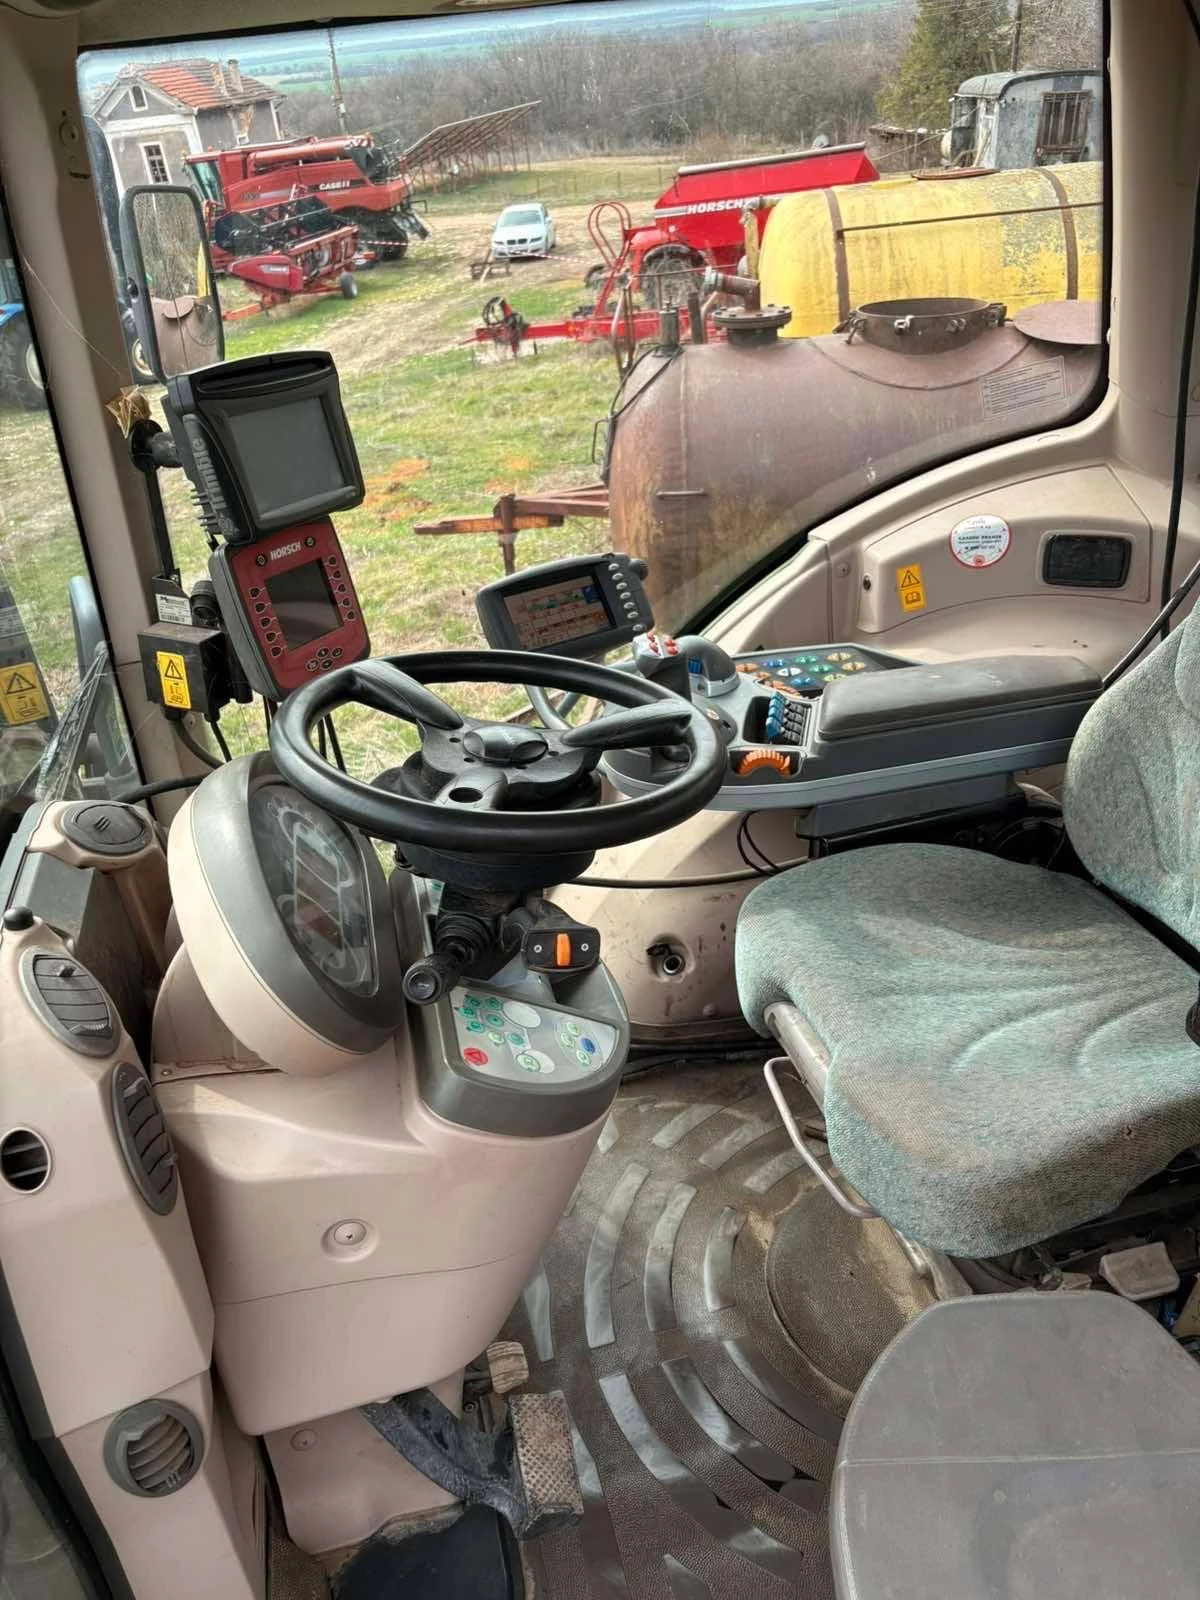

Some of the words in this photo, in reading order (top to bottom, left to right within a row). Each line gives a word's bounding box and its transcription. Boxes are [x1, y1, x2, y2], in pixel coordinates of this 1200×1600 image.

[319, 181, 342, 190] CASE
[687, 199, 743, 214] HORSCH
[270, 541, 301, 560] HORSCH
